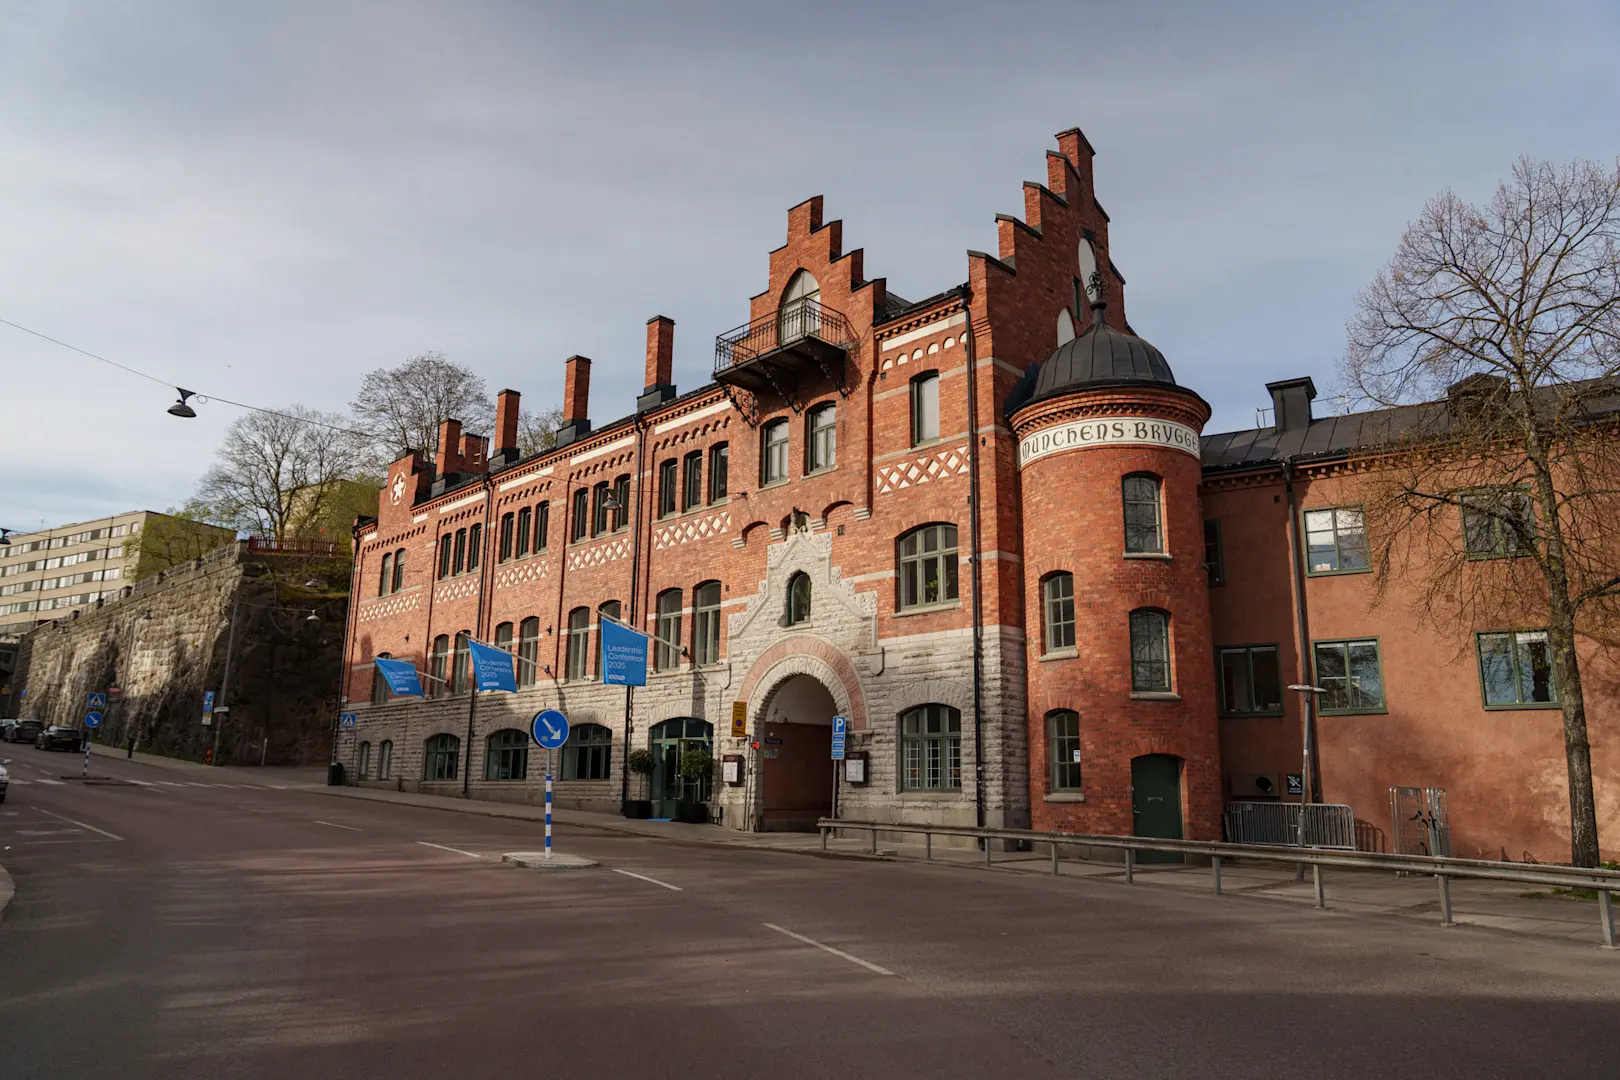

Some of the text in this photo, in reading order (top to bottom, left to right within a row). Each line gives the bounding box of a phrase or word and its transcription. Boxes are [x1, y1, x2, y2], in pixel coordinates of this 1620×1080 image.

[608, 645, 643, 654] Leadership
[608, 653, 644, 662] Conference
[608, 661, 626, 669] 2025
[836, 718, 844, 732] P
